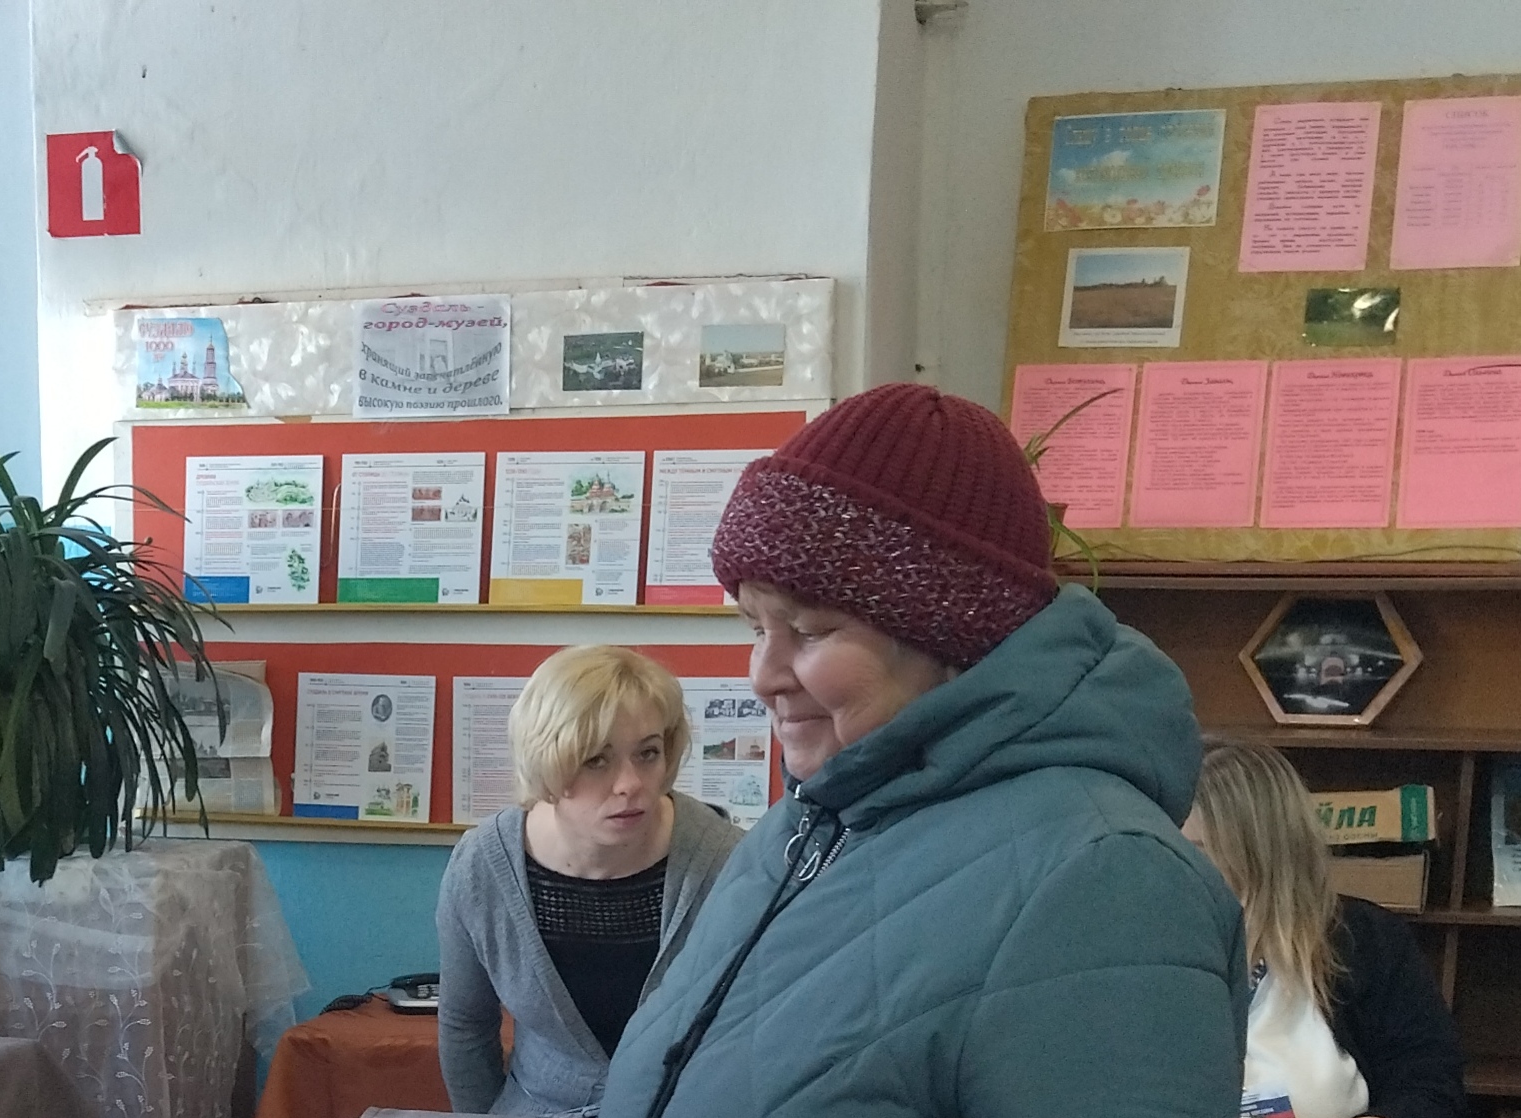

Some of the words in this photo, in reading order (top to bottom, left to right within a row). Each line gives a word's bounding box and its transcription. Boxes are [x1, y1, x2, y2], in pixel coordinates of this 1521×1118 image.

[363, 316, 508, 331] город-музей,
[370, 373, 422, 394] камне
[427, 385, 438, 394] и
[442, 368, 500, 395] дереве
[358, 395, 404, 412] высокую
